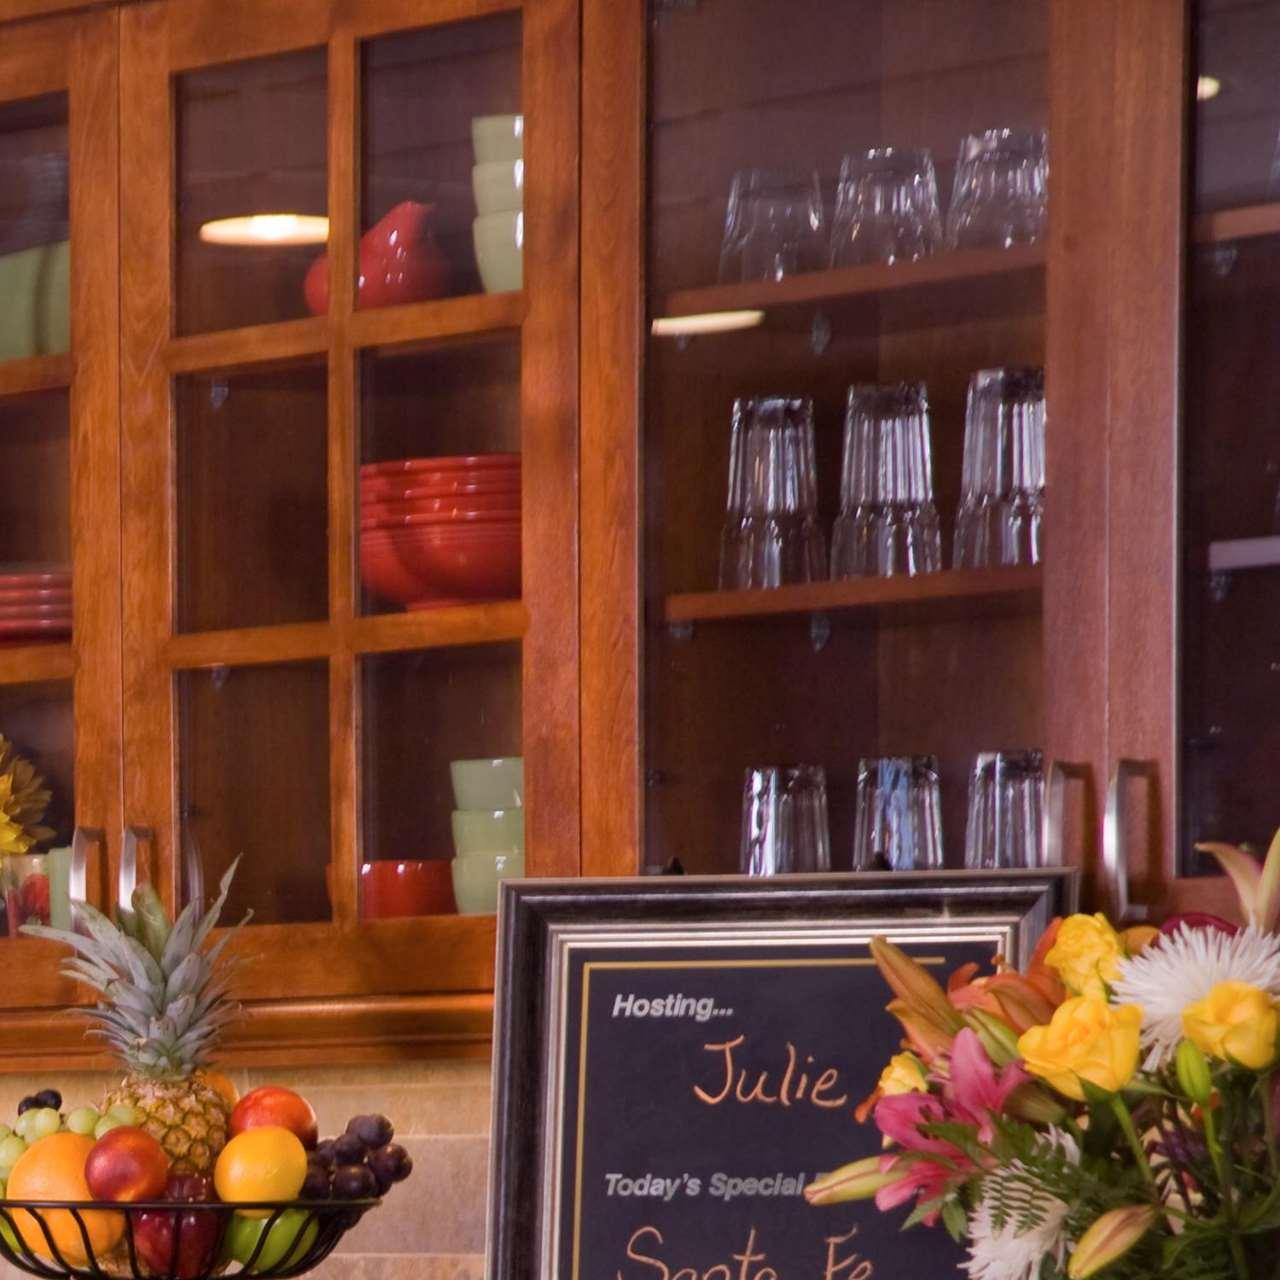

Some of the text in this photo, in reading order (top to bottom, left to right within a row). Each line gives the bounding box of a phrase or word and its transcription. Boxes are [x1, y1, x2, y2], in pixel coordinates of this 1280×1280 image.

[612, 993, 734, 1022] Hosting...
[693, 1034, 848, 1108] Julie
[605, 1172, 701, 1201] Today's
[708, 1172, 806, 1201] Special
